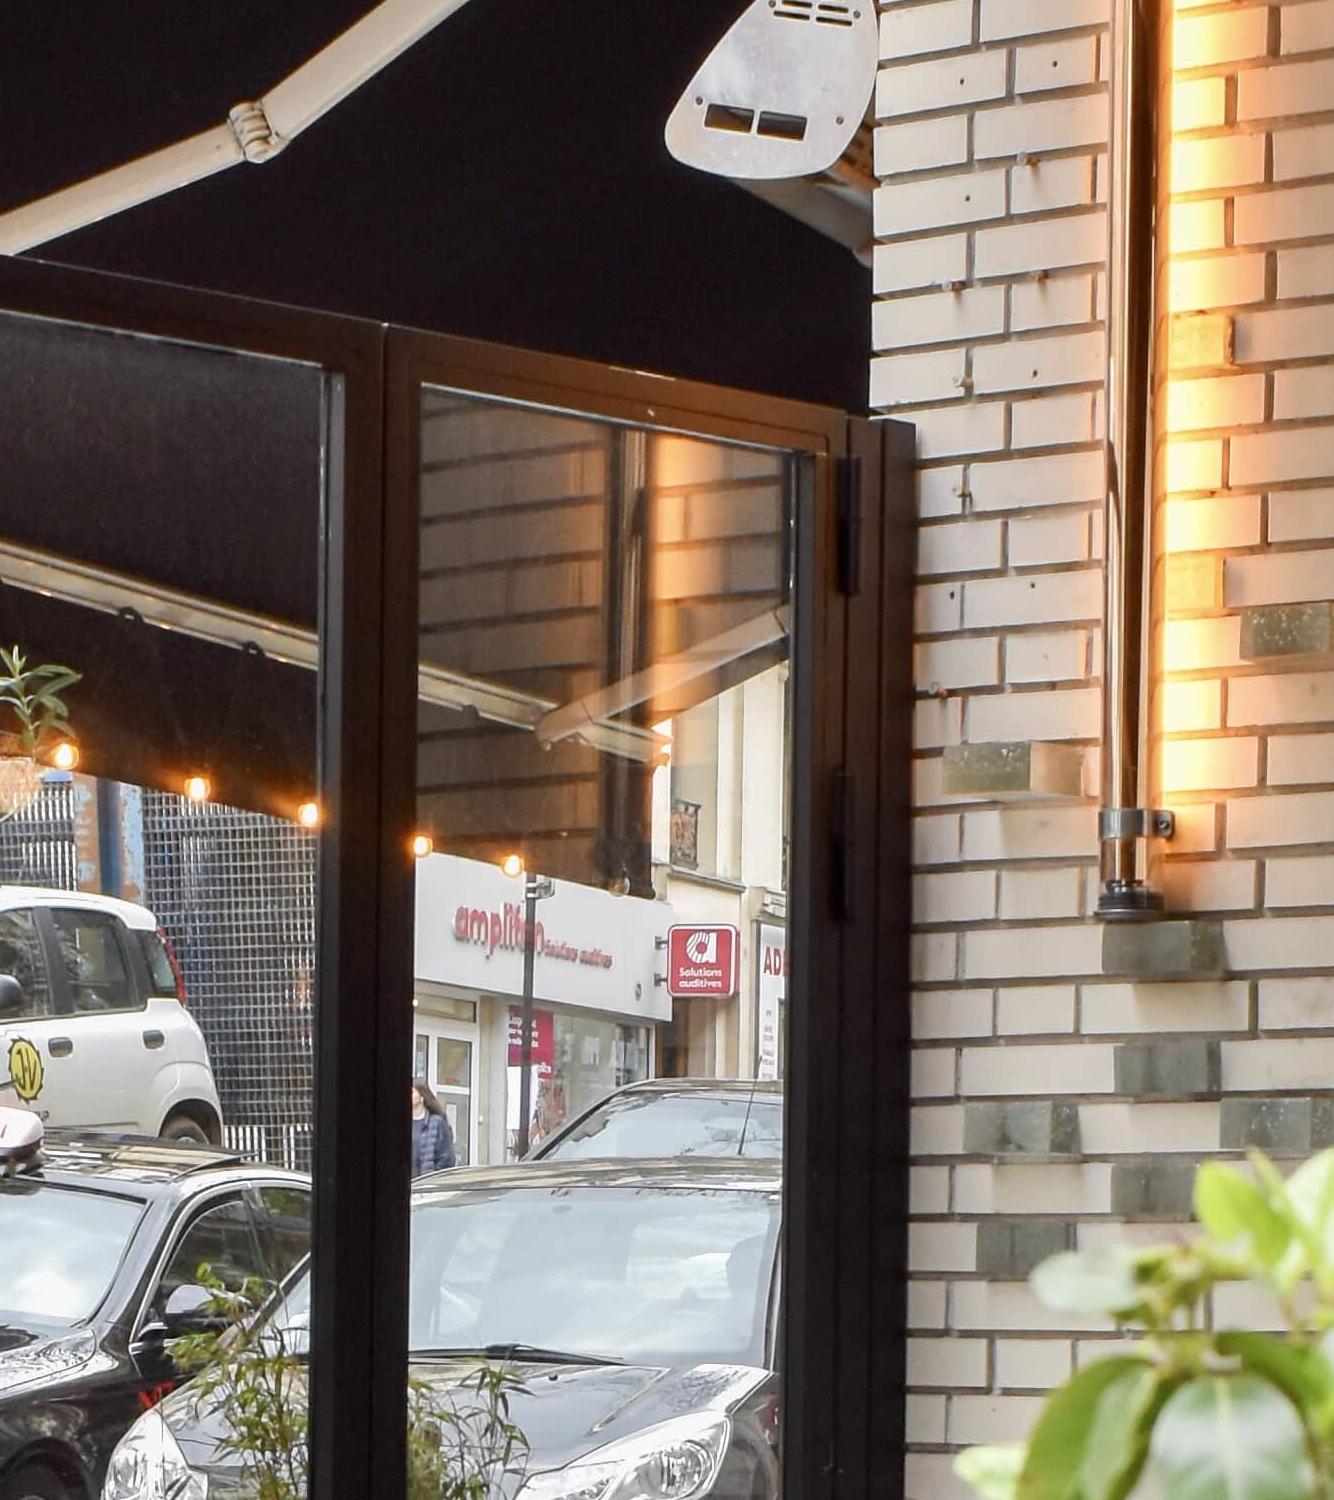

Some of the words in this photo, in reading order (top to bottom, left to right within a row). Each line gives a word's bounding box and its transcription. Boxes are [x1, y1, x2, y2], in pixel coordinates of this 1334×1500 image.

[453, 901, 545, 958] amplifn
[678, 966, 723, 978] Solutions
[678, 978, 723, 989] auditives
